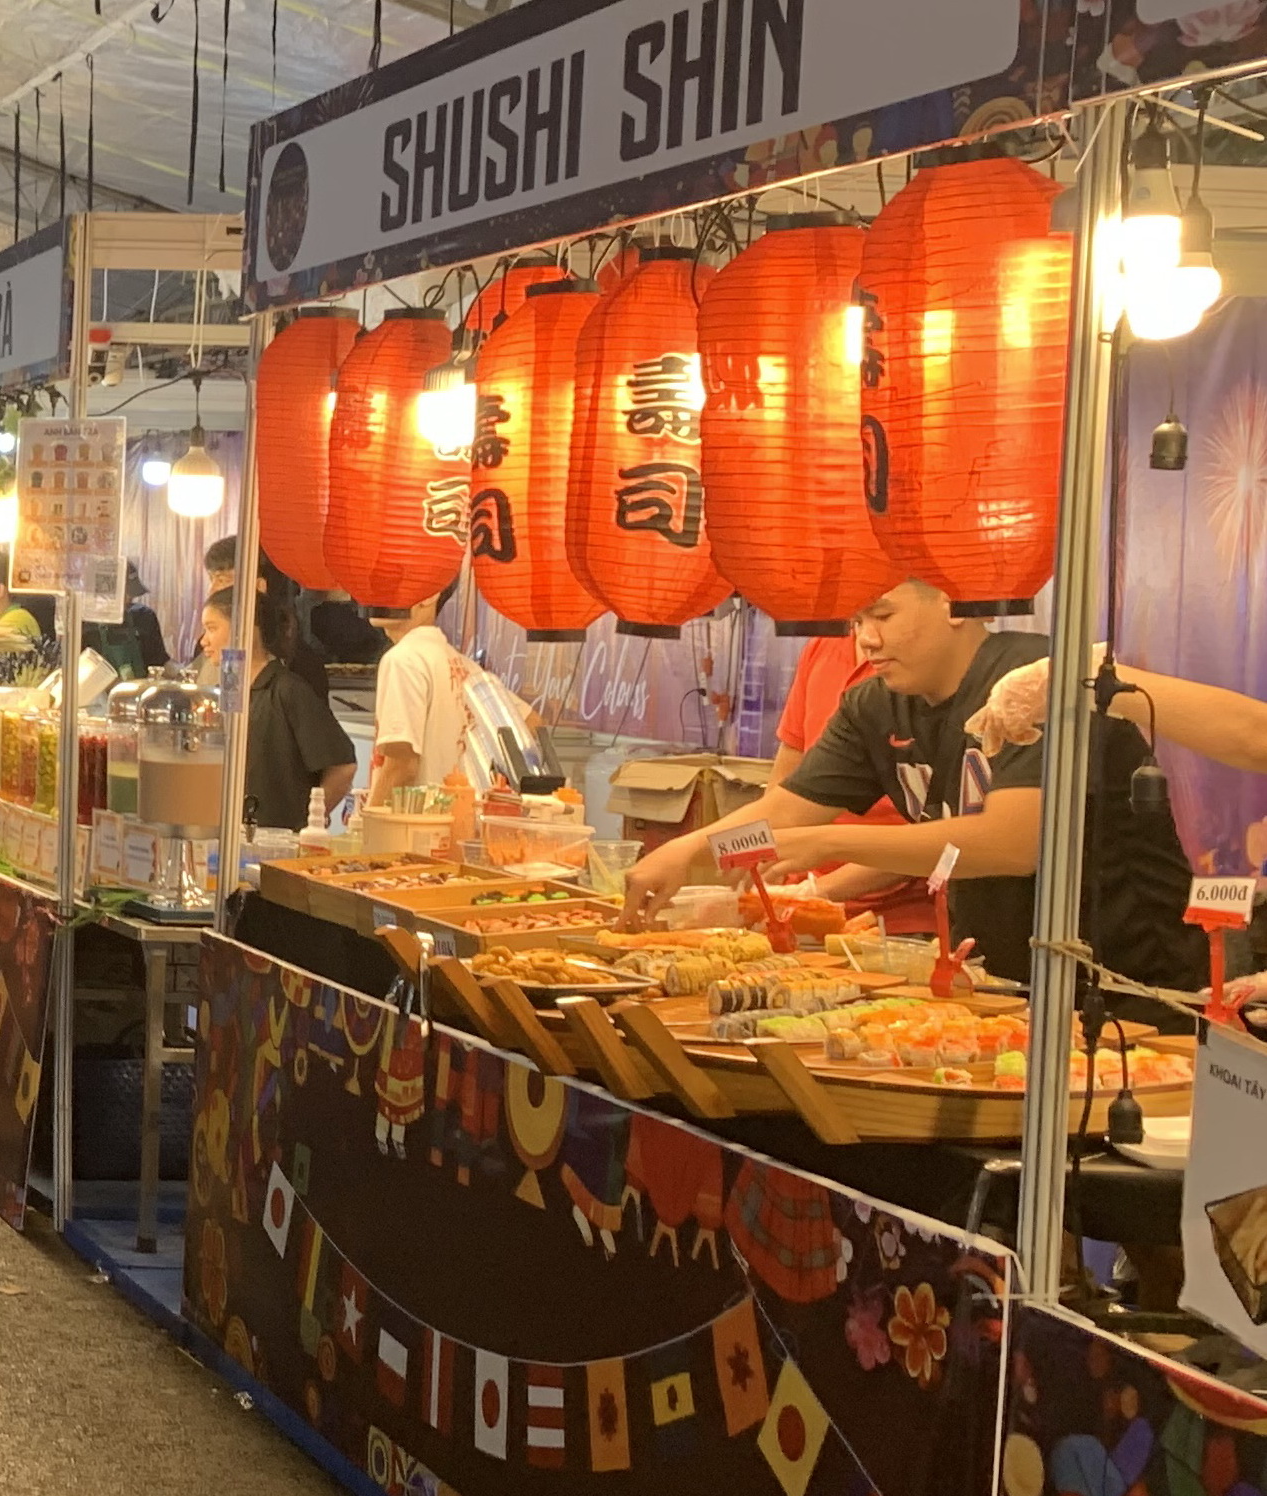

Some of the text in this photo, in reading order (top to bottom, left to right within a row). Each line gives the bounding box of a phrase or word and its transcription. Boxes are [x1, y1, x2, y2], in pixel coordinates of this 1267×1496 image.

[380, 0, 804, 233] SHUSHI SHIN
[1196, 884, 1249, 901] 6.000đ
